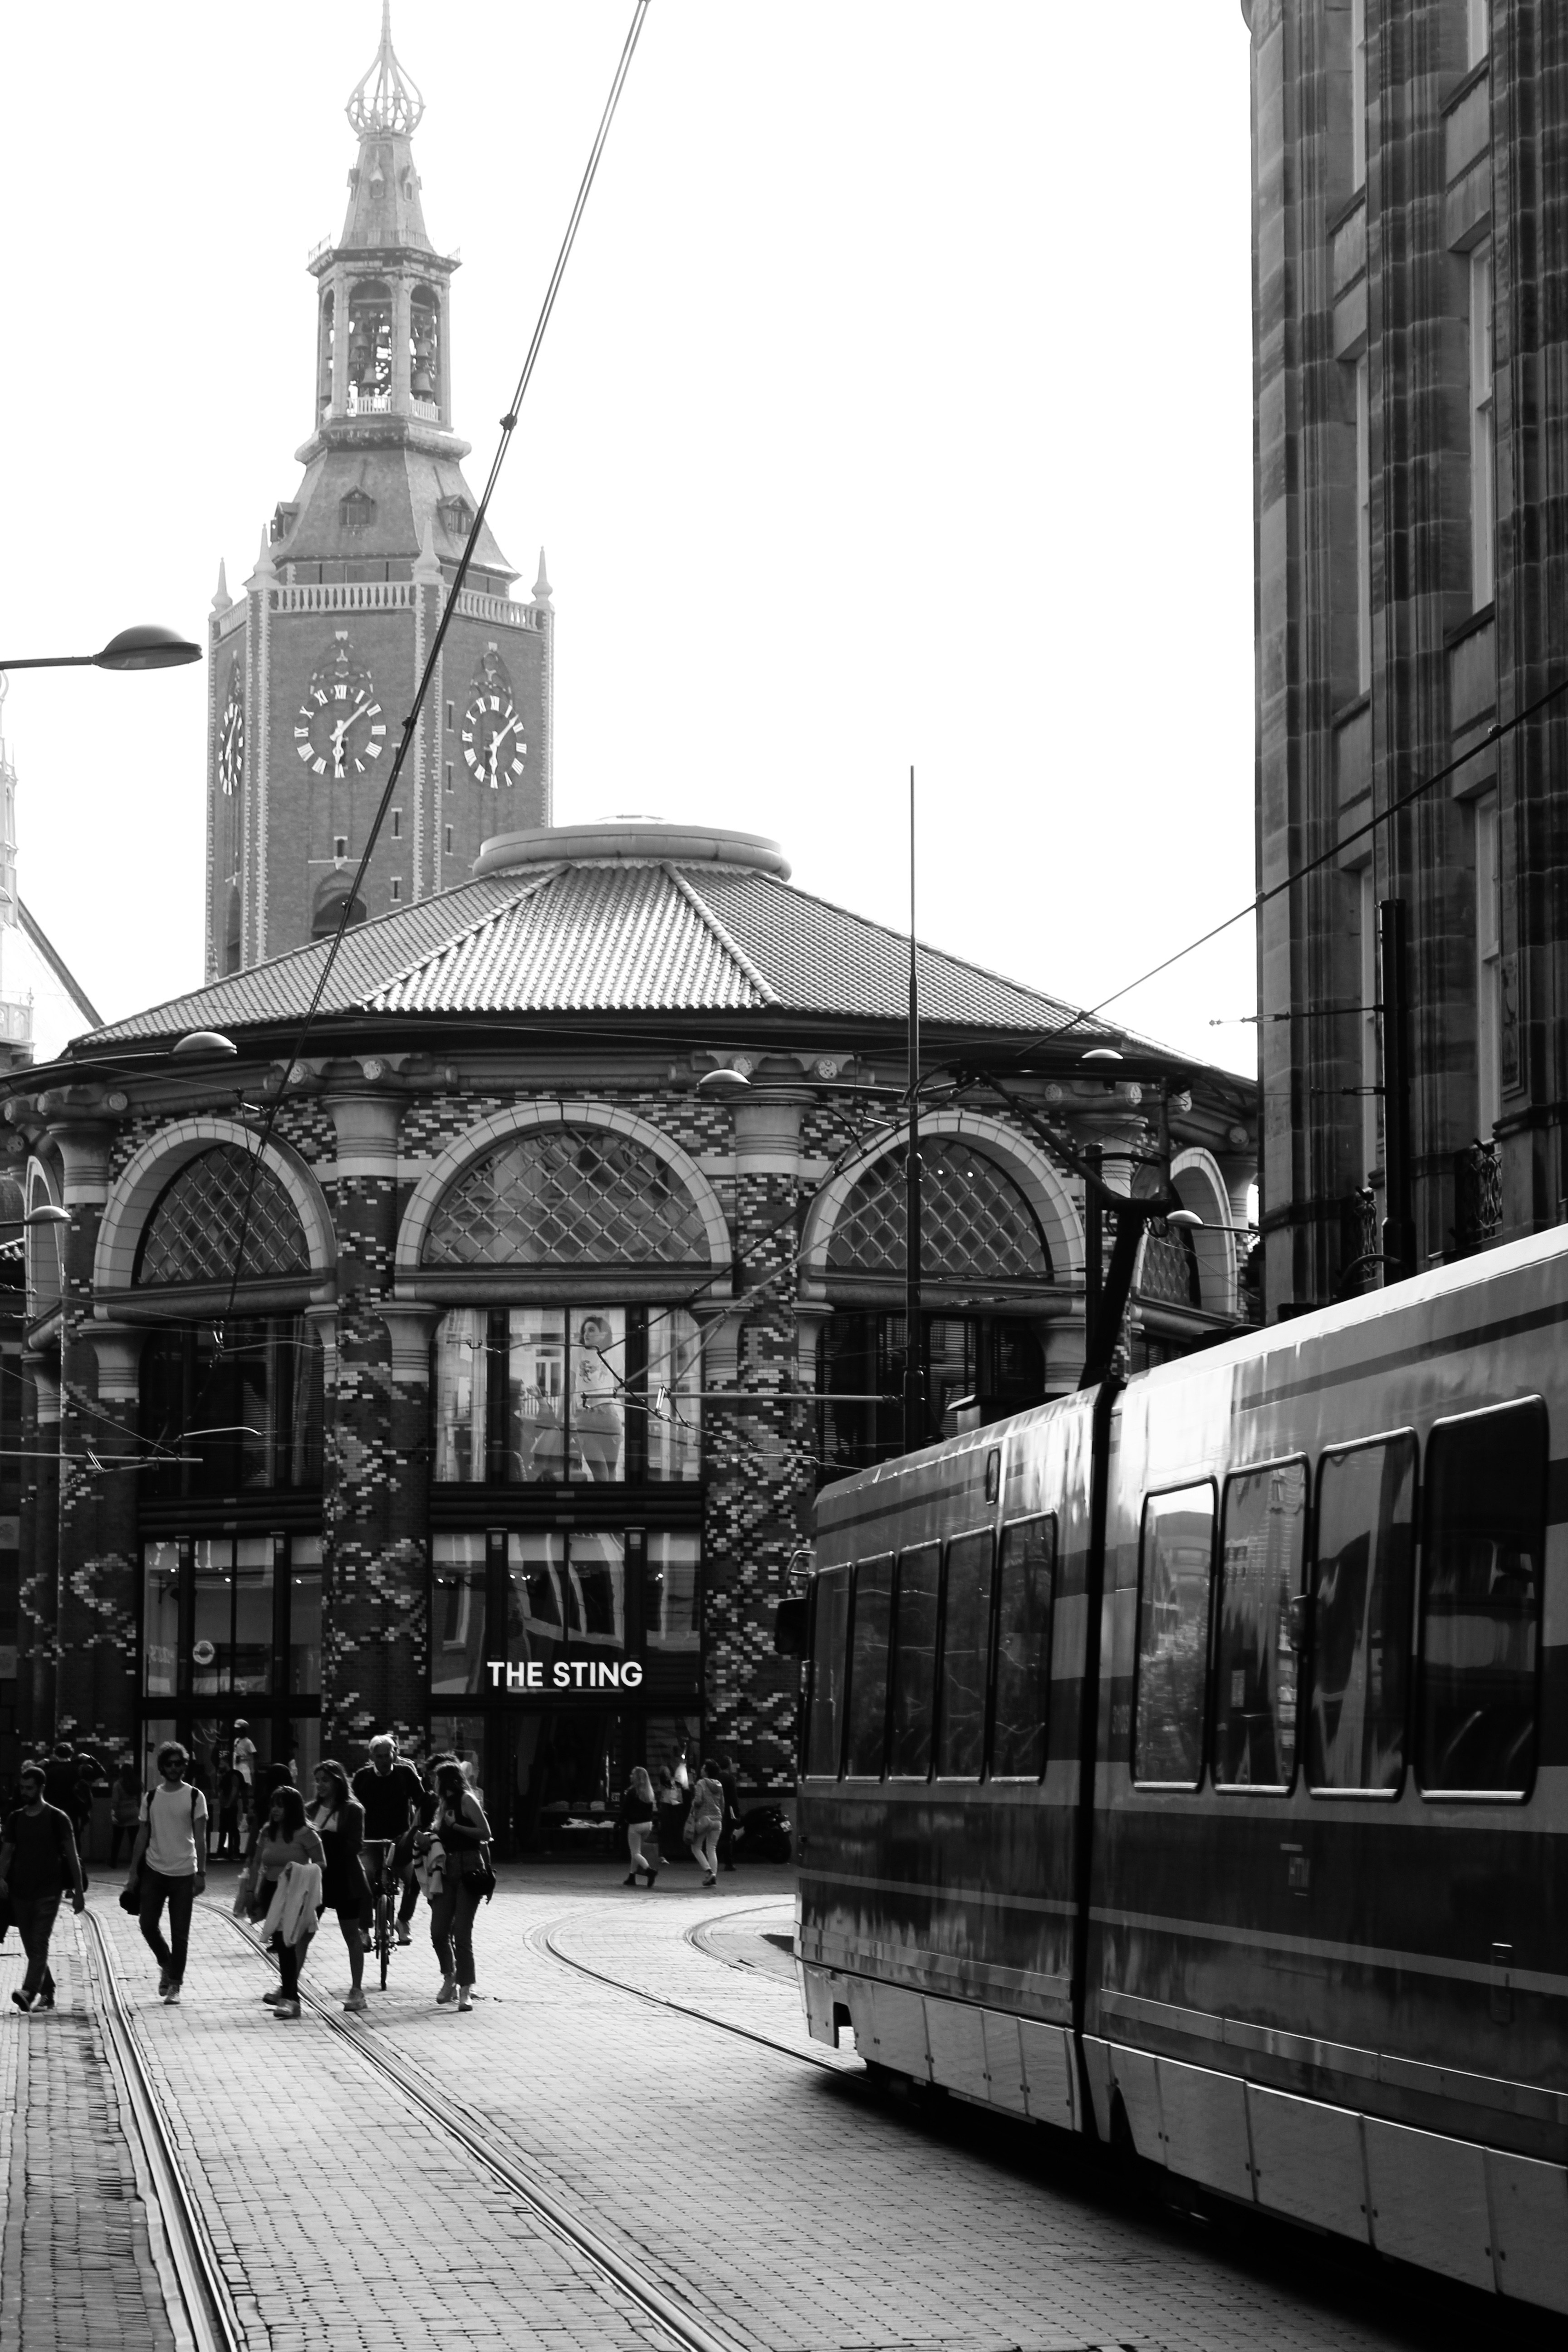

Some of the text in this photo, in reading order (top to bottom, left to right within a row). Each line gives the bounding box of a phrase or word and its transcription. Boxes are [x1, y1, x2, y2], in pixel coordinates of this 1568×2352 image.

[314, 689, 328, 706] XI
[334, 684, 347, 699] XII
[354, 689, 365, 704] I
[299, 706, 314, 719] X
[367, 703, 382, 717] II
[294, 726, 309, 737] IX
[371, 725, 386, 735] III
[365, 741, 382, 759] IIII
[334, 764, 345, 778] VI
[354, 758, 366, 773] V
[487, 1661, 643, 1687] THE STING
